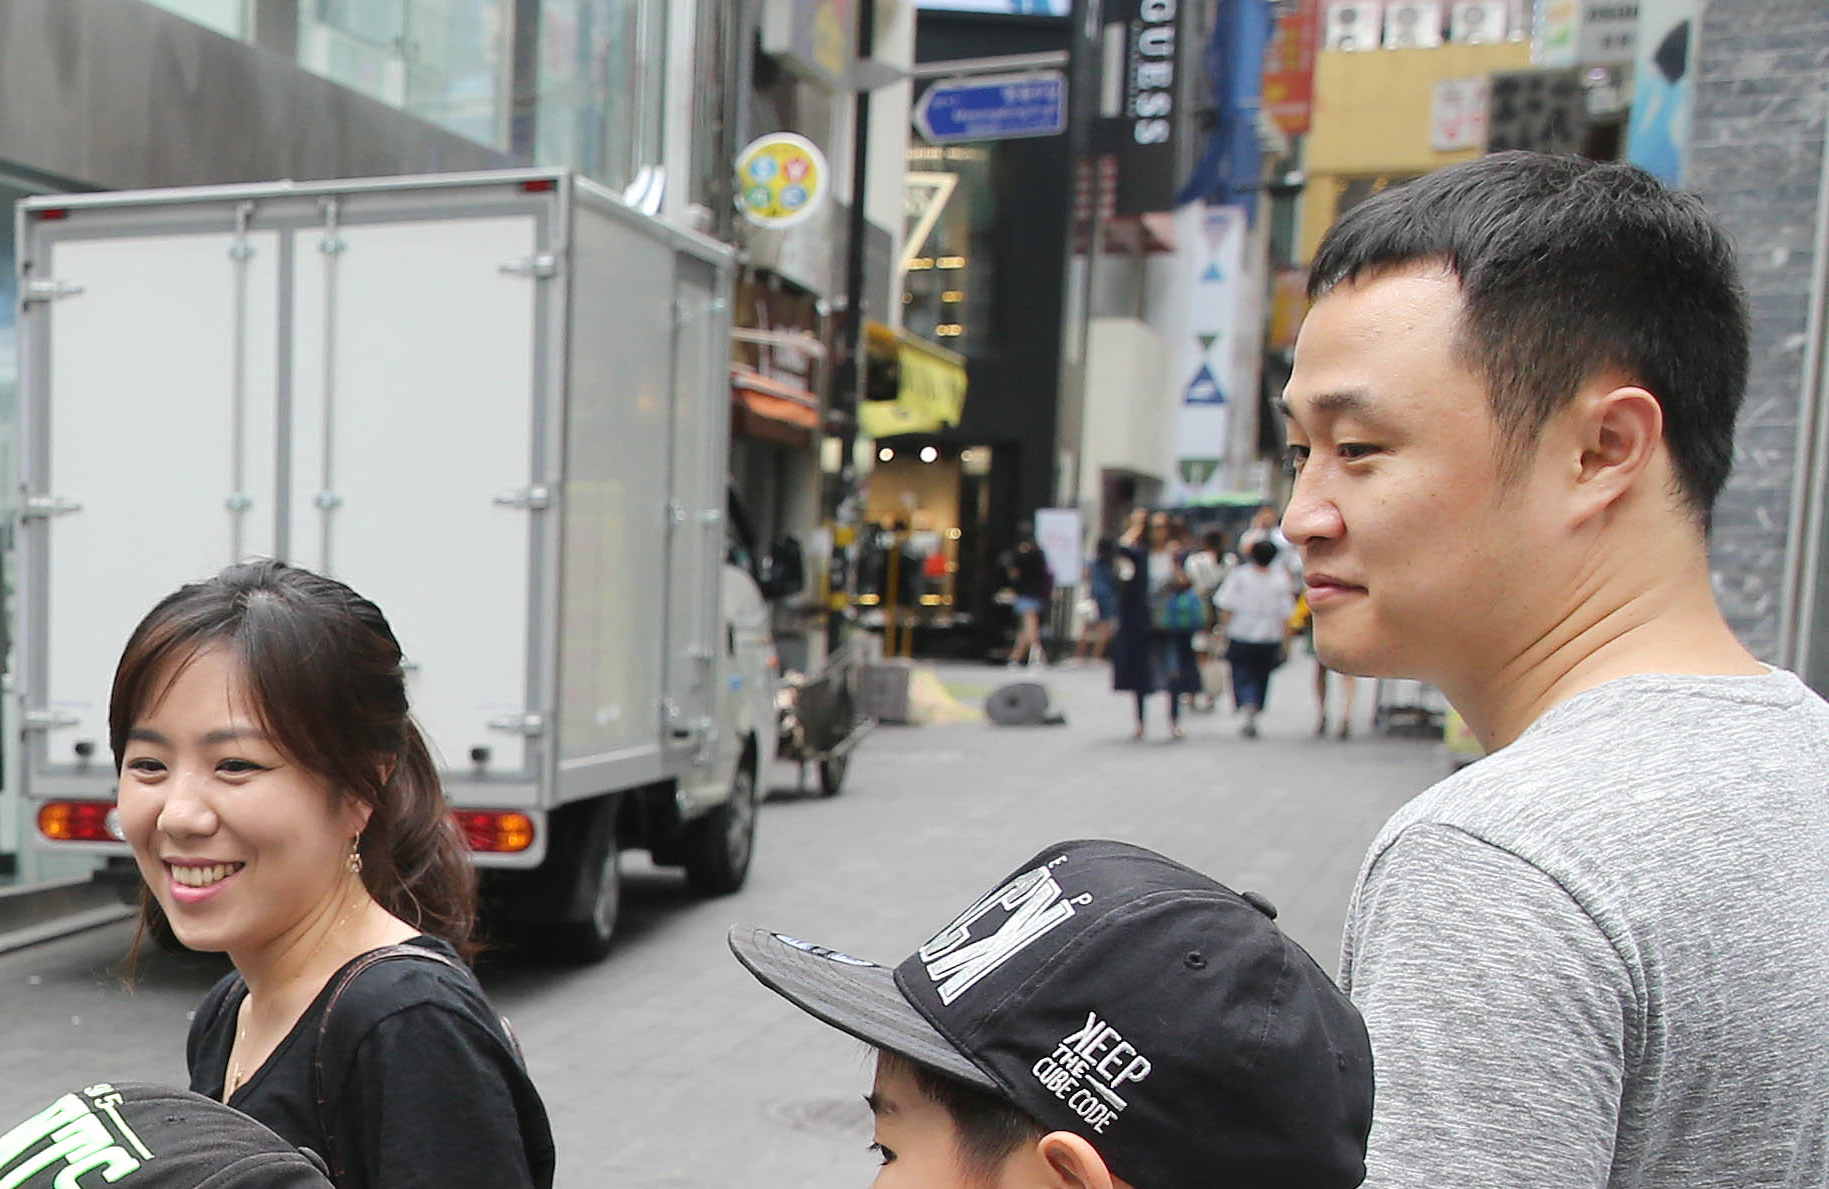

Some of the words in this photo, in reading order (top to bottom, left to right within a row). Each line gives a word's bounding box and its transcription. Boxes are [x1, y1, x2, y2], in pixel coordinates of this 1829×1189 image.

[1051, 1042, 1091, 1079] THE
[1062, 1011, 1152, 1089] KEEP
[1032, 1056, 1081, 1100] CUBE
[1068, 1088, 1119, 1135] CODE
